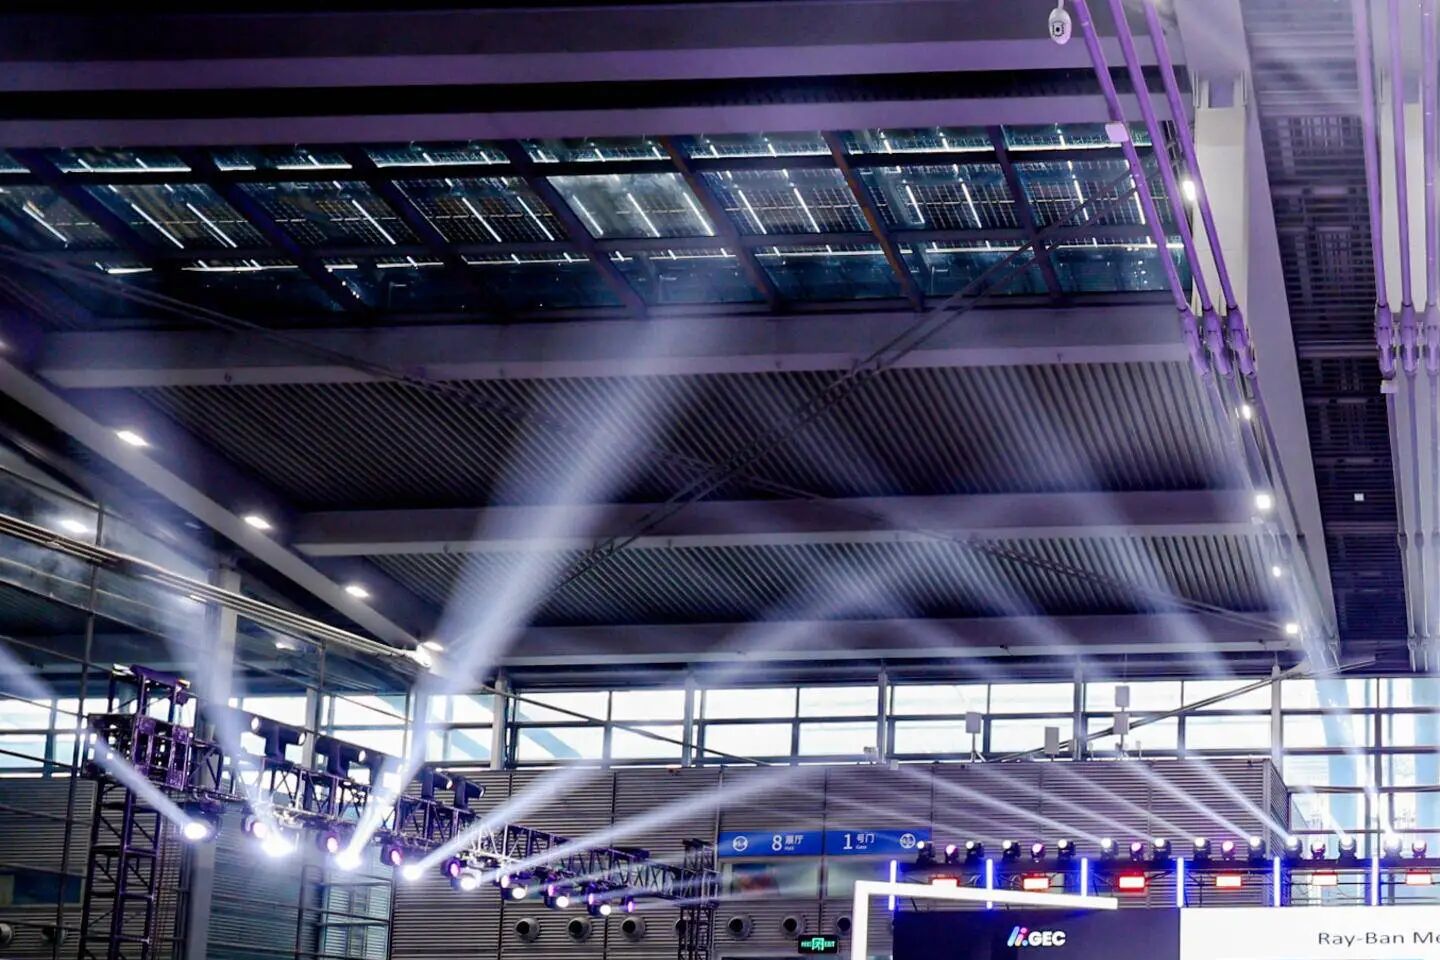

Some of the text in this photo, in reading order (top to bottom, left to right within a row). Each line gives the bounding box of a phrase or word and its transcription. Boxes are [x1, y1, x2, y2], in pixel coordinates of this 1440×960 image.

[771, 834, 783, 852] 8
[843, 833, 875, 850] 1 号门
[1317, 931, 1405, 947] Ray-Ban
